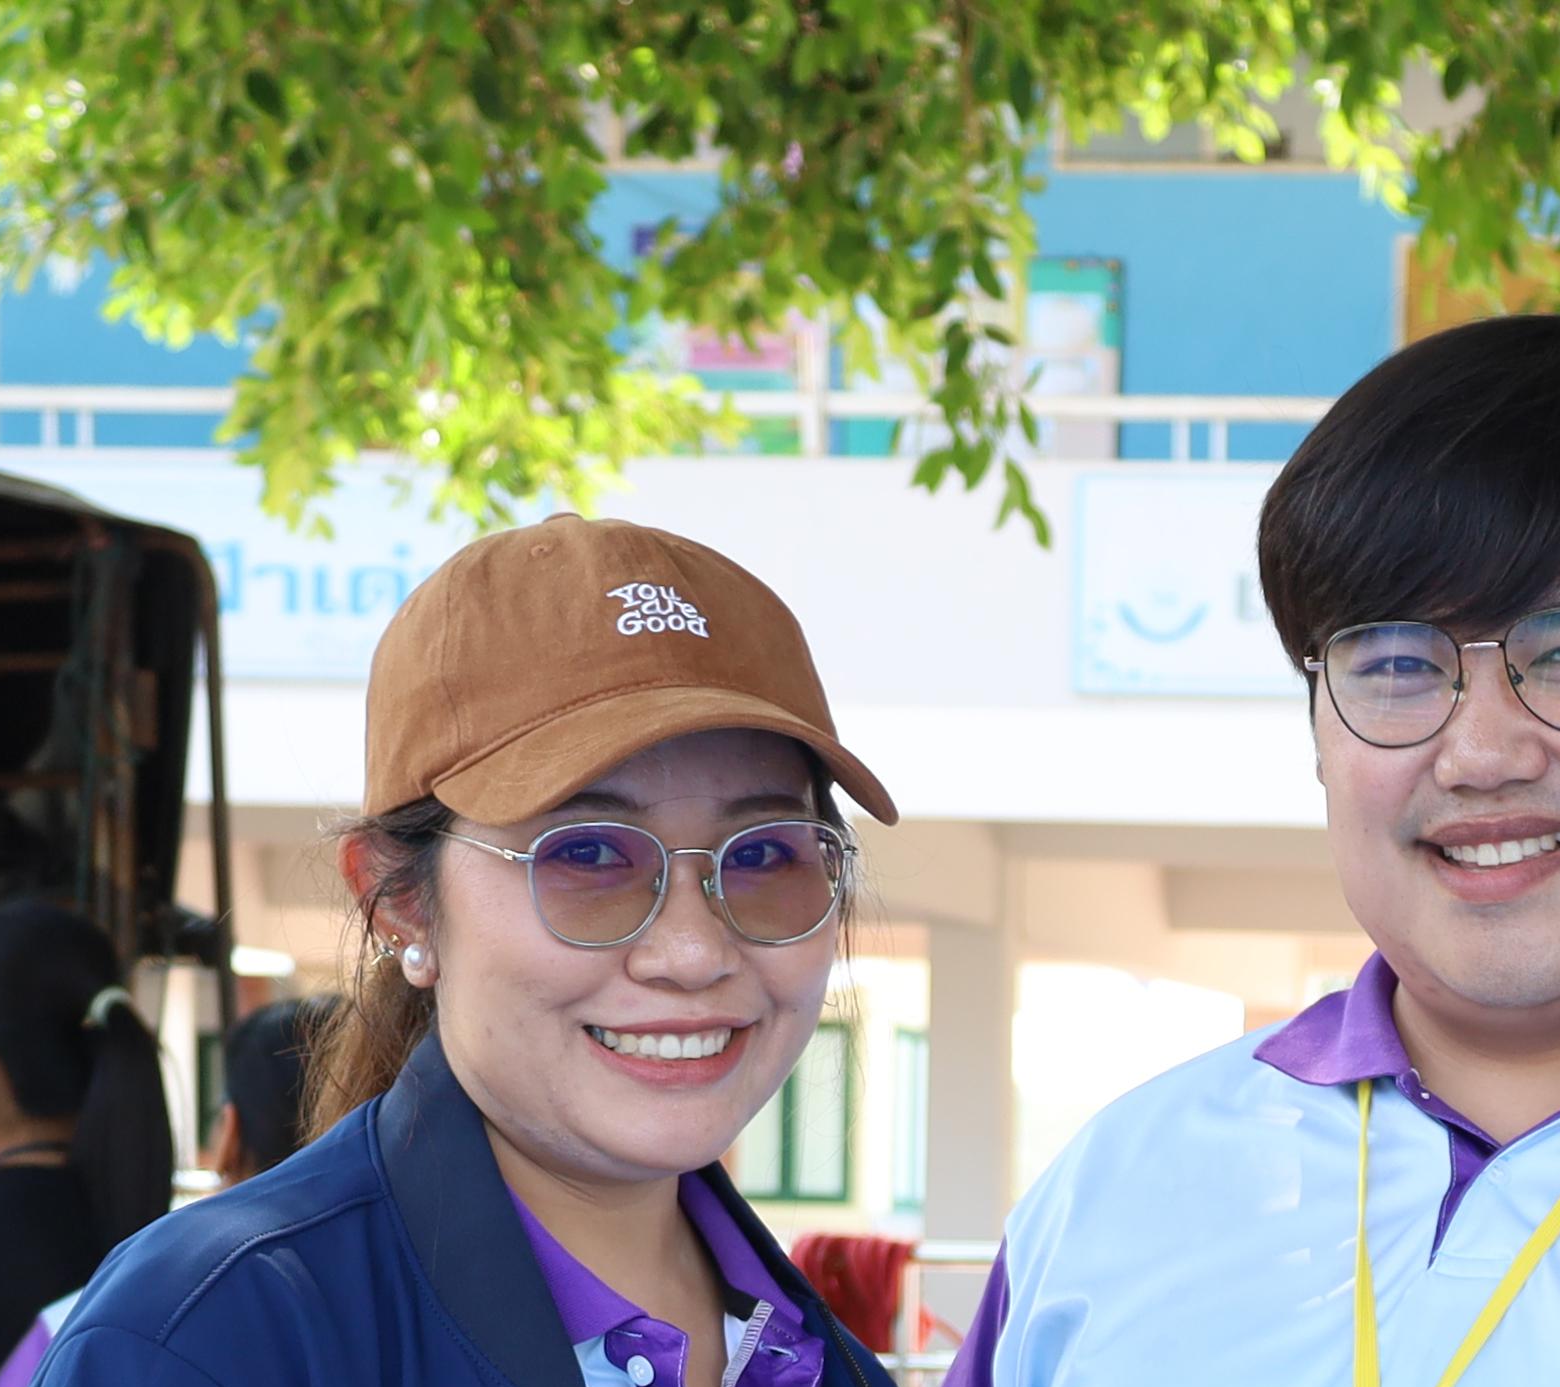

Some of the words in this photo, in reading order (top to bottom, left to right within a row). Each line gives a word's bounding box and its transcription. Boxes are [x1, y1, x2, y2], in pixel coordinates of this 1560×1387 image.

[606, 583, 682, 609] You
[640, 597, 698, 618] are
[617, 609, 710, 638] Good
